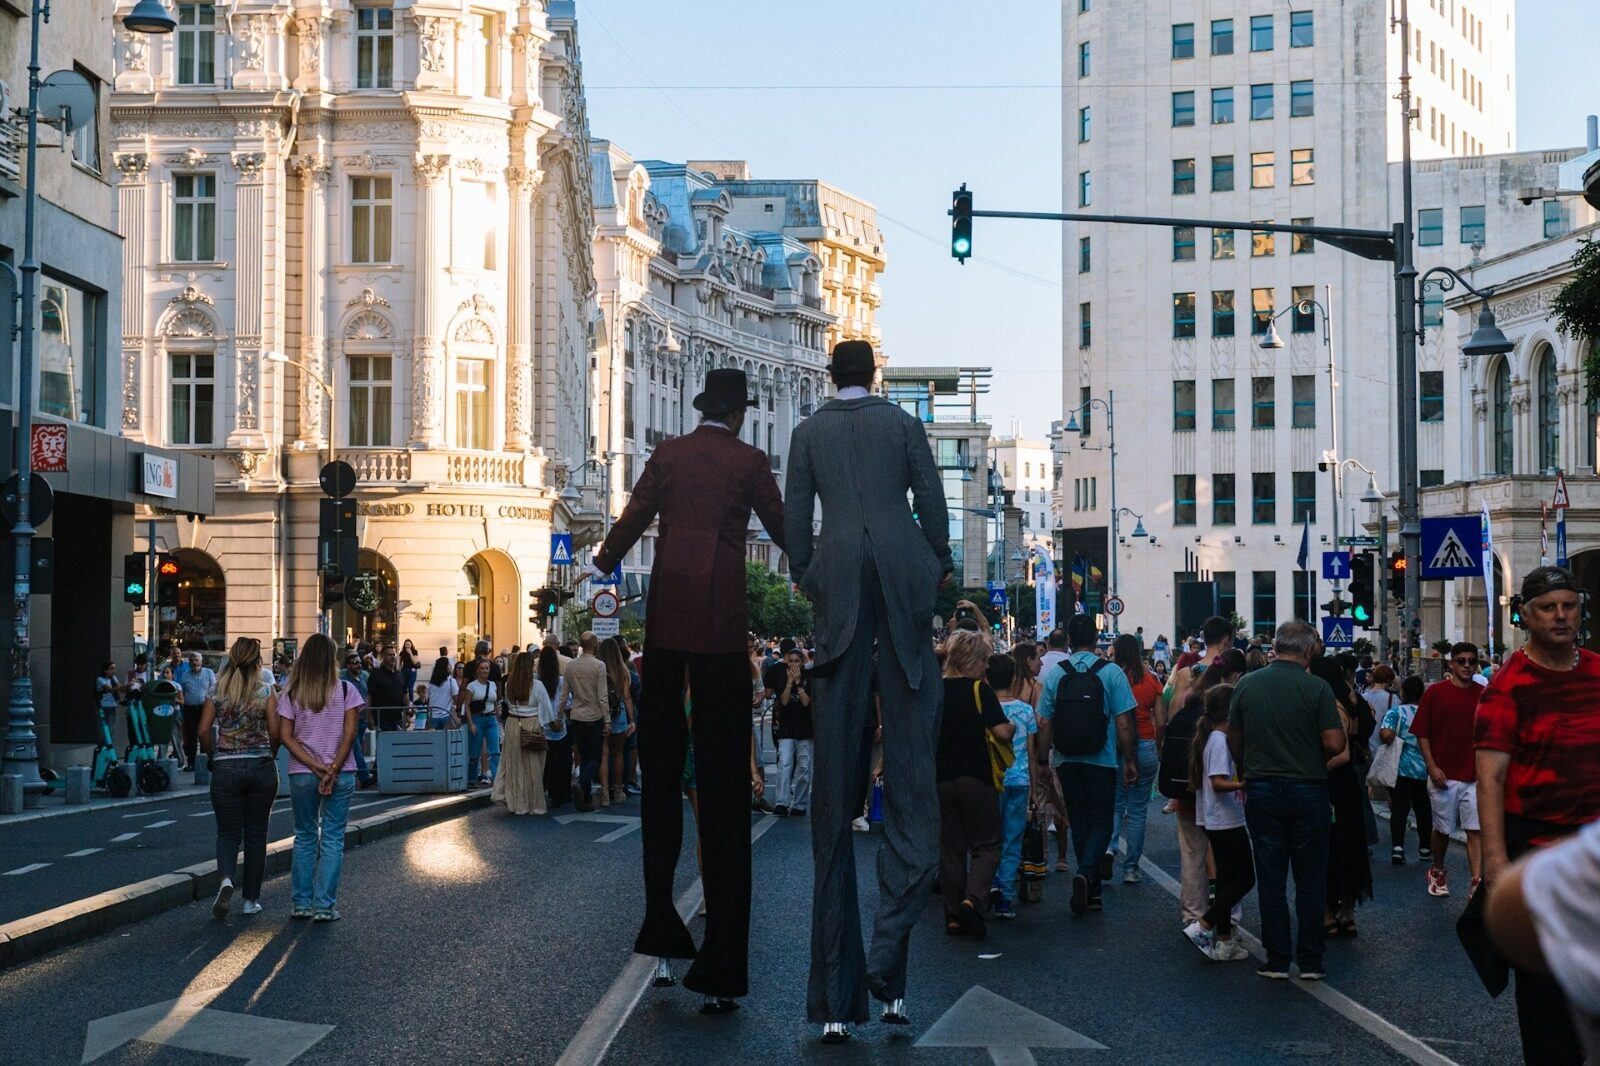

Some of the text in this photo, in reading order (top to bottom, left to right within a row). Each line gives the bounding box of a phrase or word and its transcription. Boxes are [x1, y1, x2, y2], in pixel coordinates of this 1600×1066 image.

[146, 461, 162, 487] ING
[356, 503, 415, 517] RAND
[428, 503, 488, 517] HOTEL
[1110, 602, 1120, 612] 30
